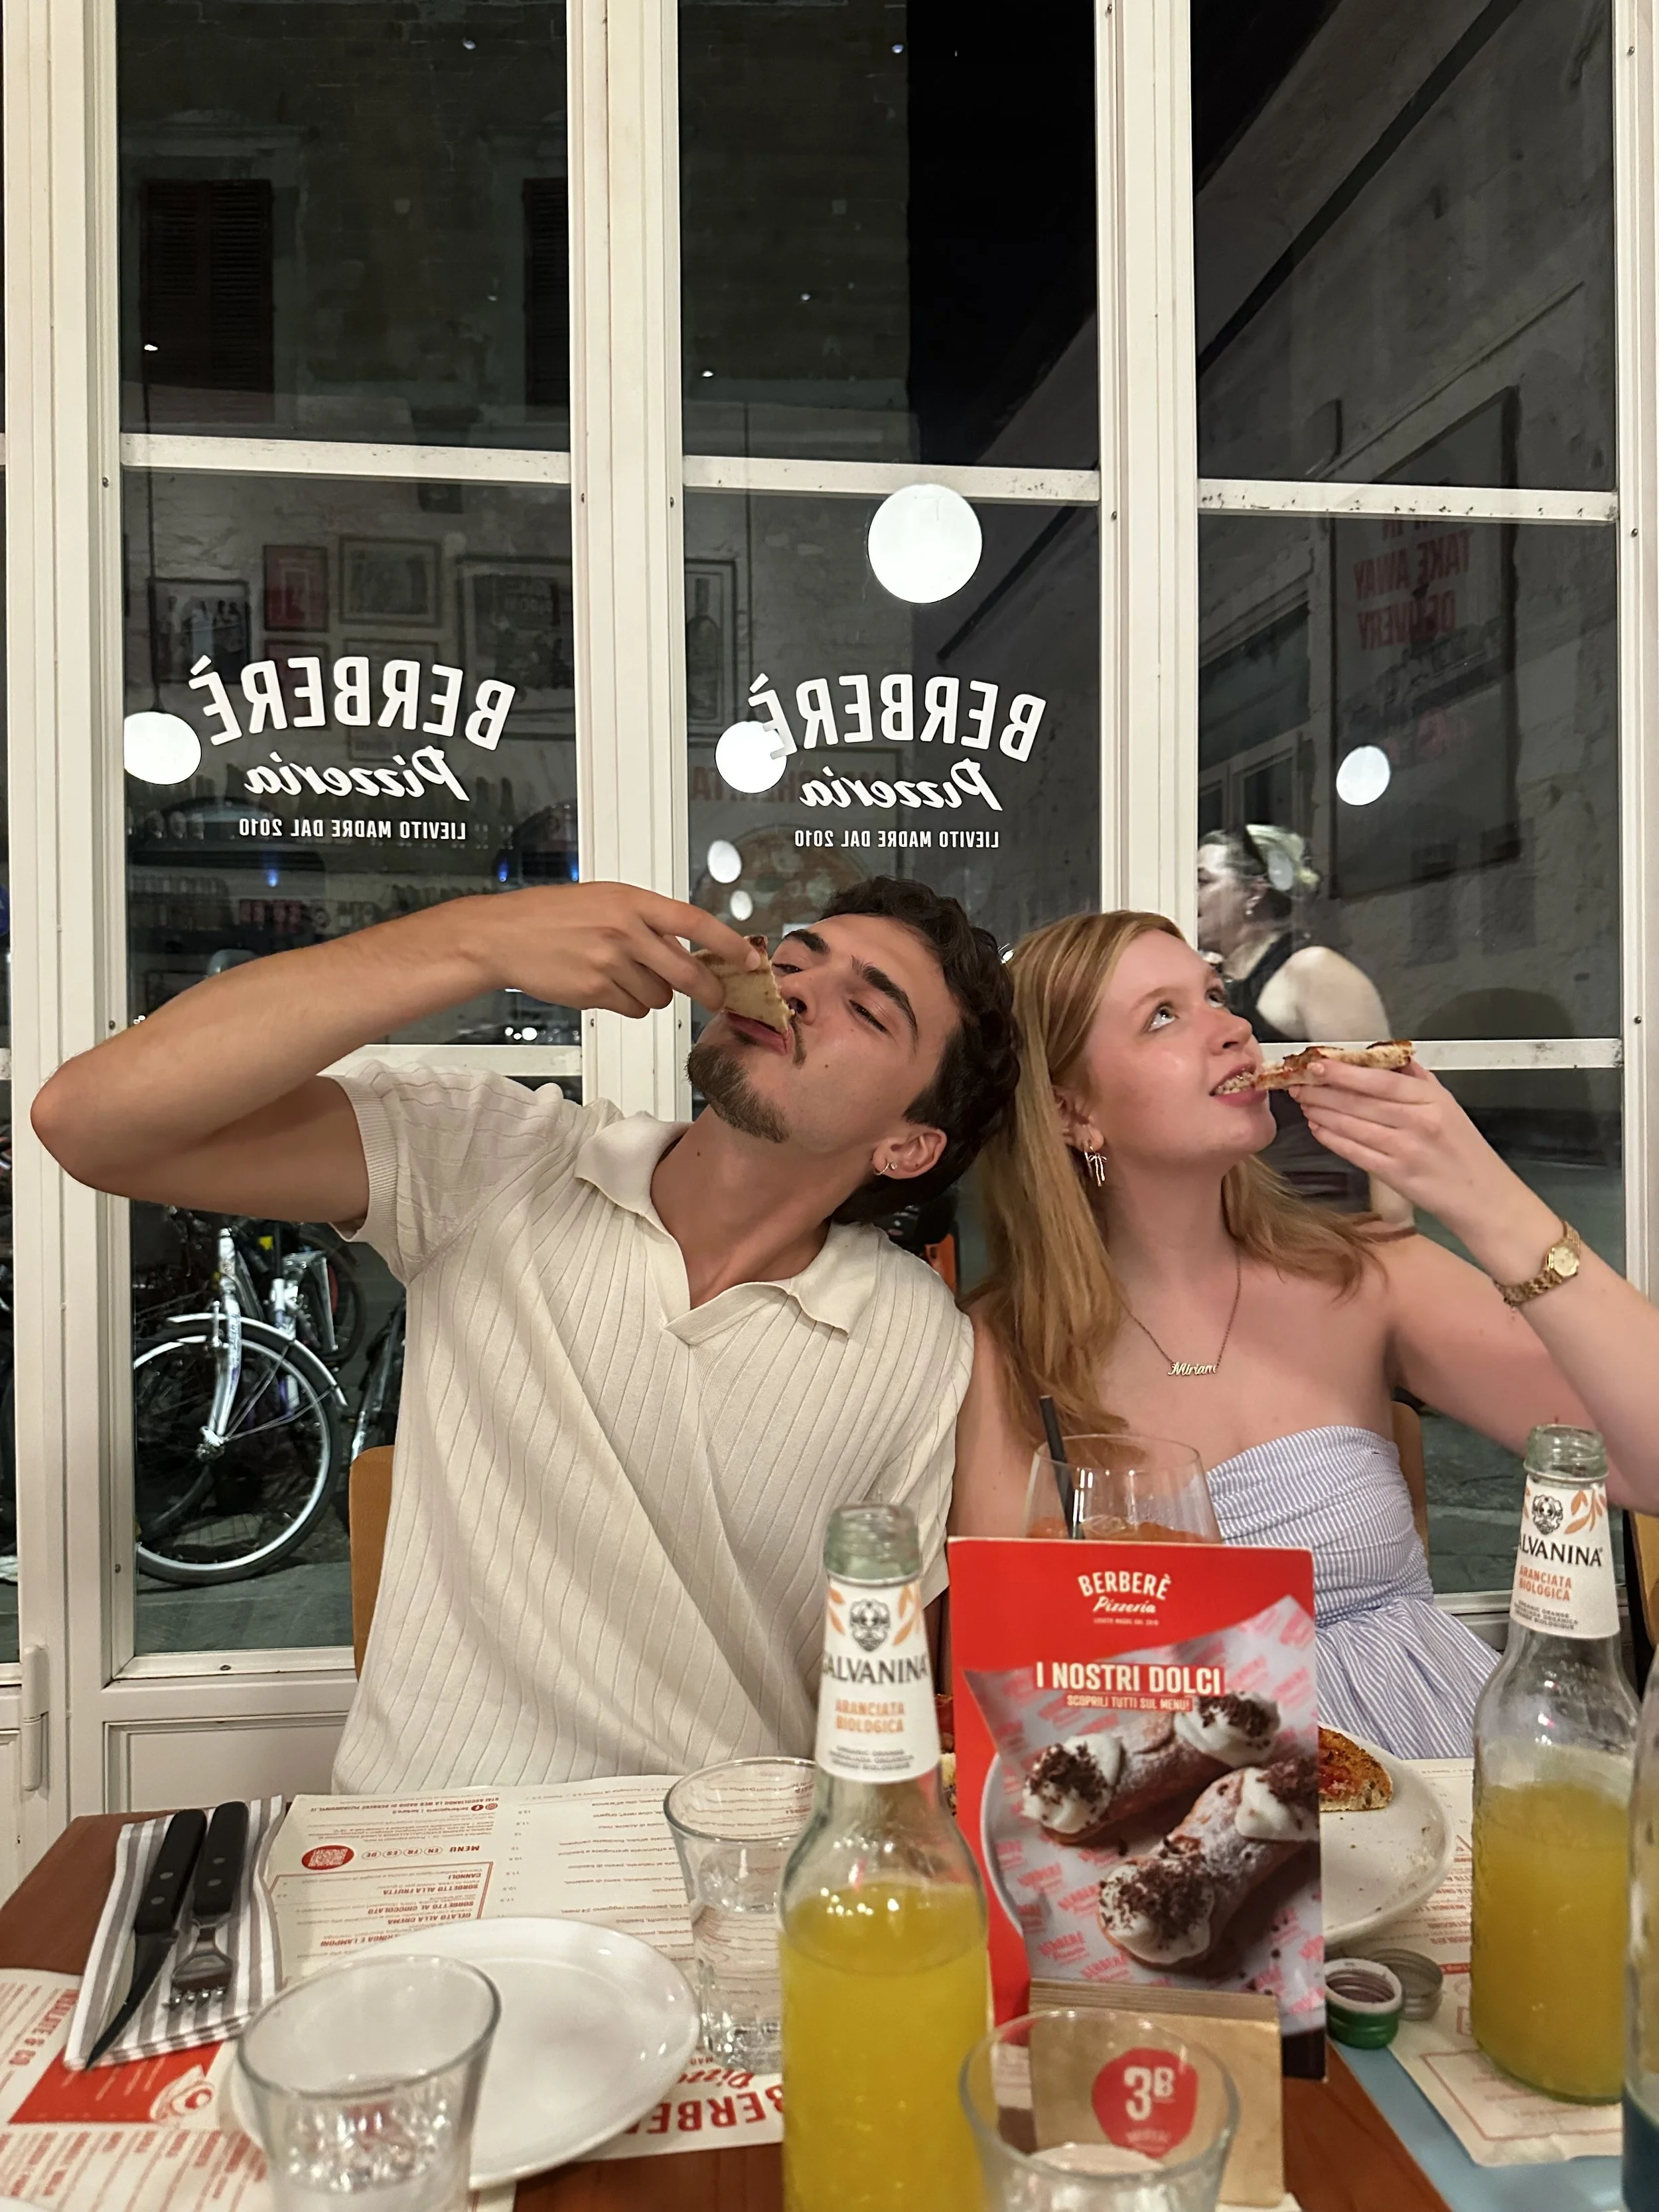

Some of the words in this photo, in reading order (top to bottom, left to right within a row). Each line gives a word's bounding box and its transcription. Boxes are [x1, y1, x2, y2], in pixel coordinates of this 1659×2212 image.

[1168, 1361, 1216, 1376] Miriam
[1518, 1534, 1602, 1566] LVANINA
[1078, 1571, 1171, 1601] BERBERÈ
[1520, 1565, 1571, 1588] ARANCIATA
[1519, 1578, 1570, 1601] BIOLOGICA
[1093, 1595, 1156, 1613] Pizzeria
[1037, 1661, 1044, 1688] I
[1052, 1662, 1140, 1692] NOSTRI
[1149, 1666, 1220, 1695] DOLCI
[835, 1698, 904, 1716] ARANCIATA
[1112, 1696, 1137, 1708] TUTTI
[1139, 1698, 1157, 1709] SUL
[836, 1715, 904, 1733] BIOLOGICA
[368, 1905, 417, 1915] CIOCCOLATO
[1124, 2065, 1175, 2121] 3B
[622, 2085, 784, 2135] BERBE
